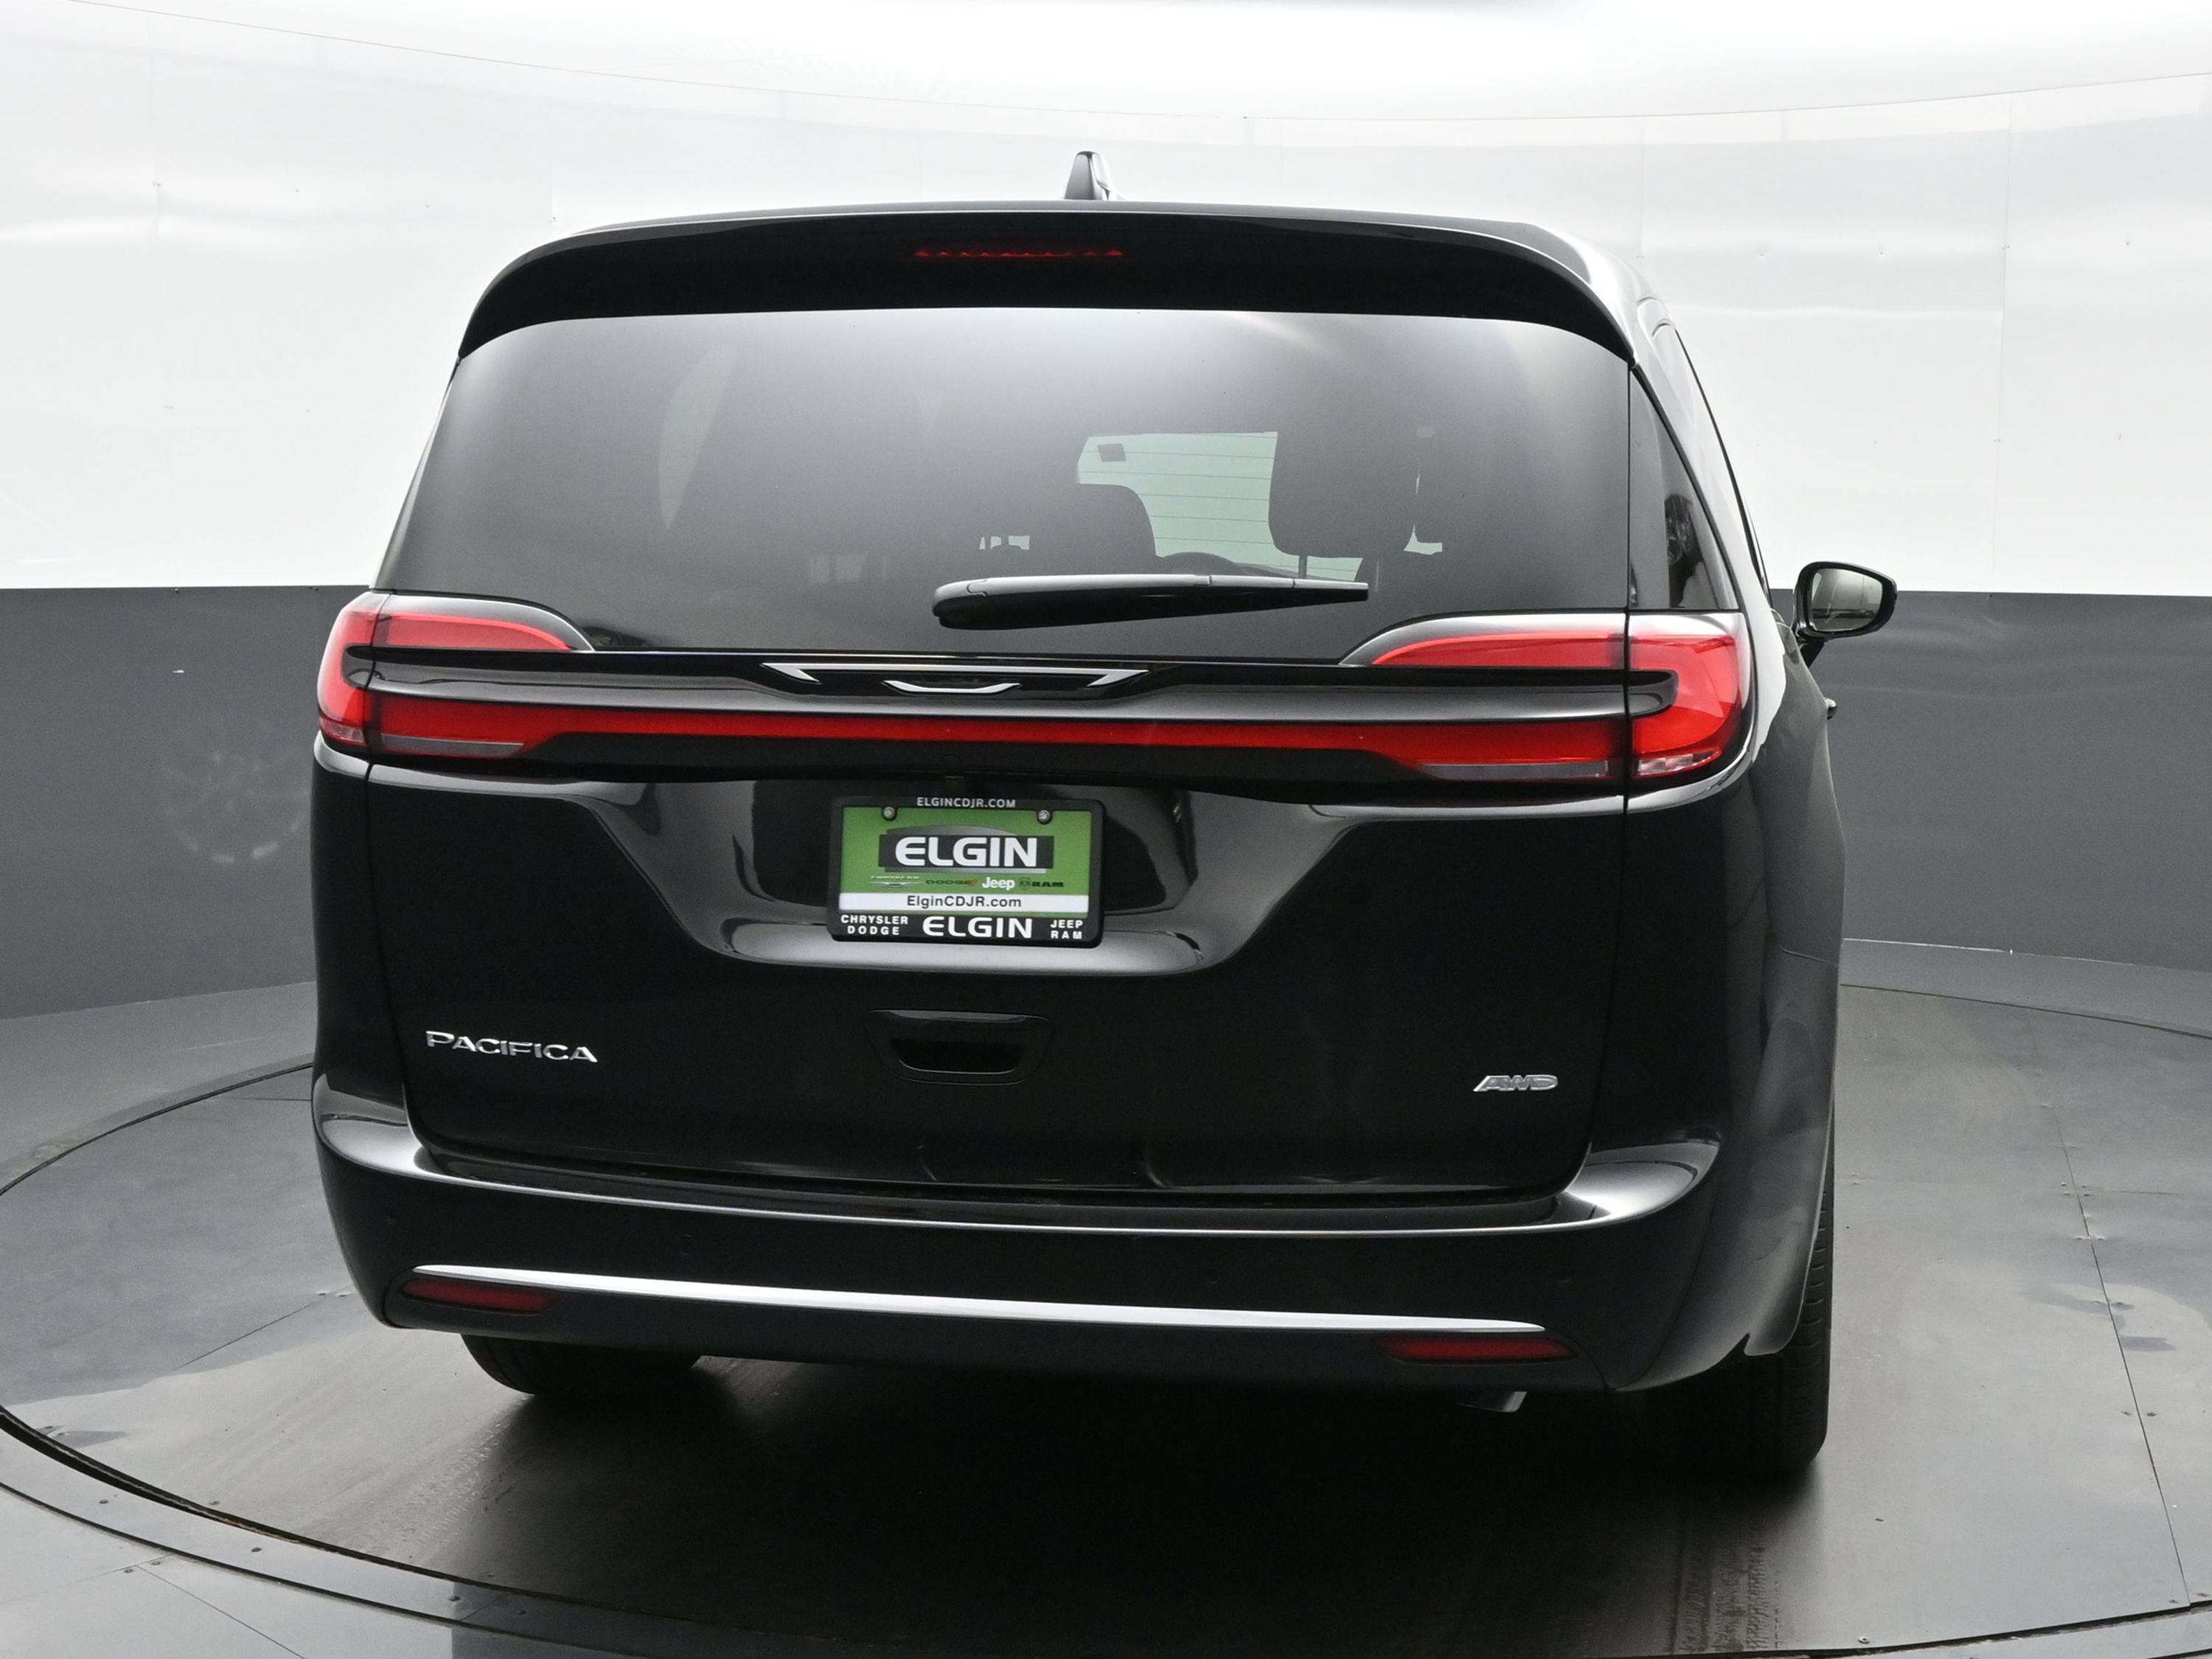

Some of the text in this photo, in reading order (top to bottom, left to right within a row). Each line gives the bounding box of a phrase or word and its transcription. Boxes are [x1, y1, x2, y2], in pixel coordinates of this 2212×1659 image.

[917, 797, 1016, 808] ELGINCDJR.COM
[895, 836, 1037, 867] ELGIN
[981, 876, 1015, 891] Jeep
[907, 895, 1022, 908] ElginCDJR.com
[841, 914, 908, 925] CHRYSLER
[1050, 919, 1083, 928] JEEP
[847, 925, 900, 936] DODGE
[922, 916, 1032, 939] ELGIN
[1050, 930, 1082, 939] RAM
[425, 1029, 598, 1063] PACIFICA
[1473, 1074, 1559, 1092] AWD
